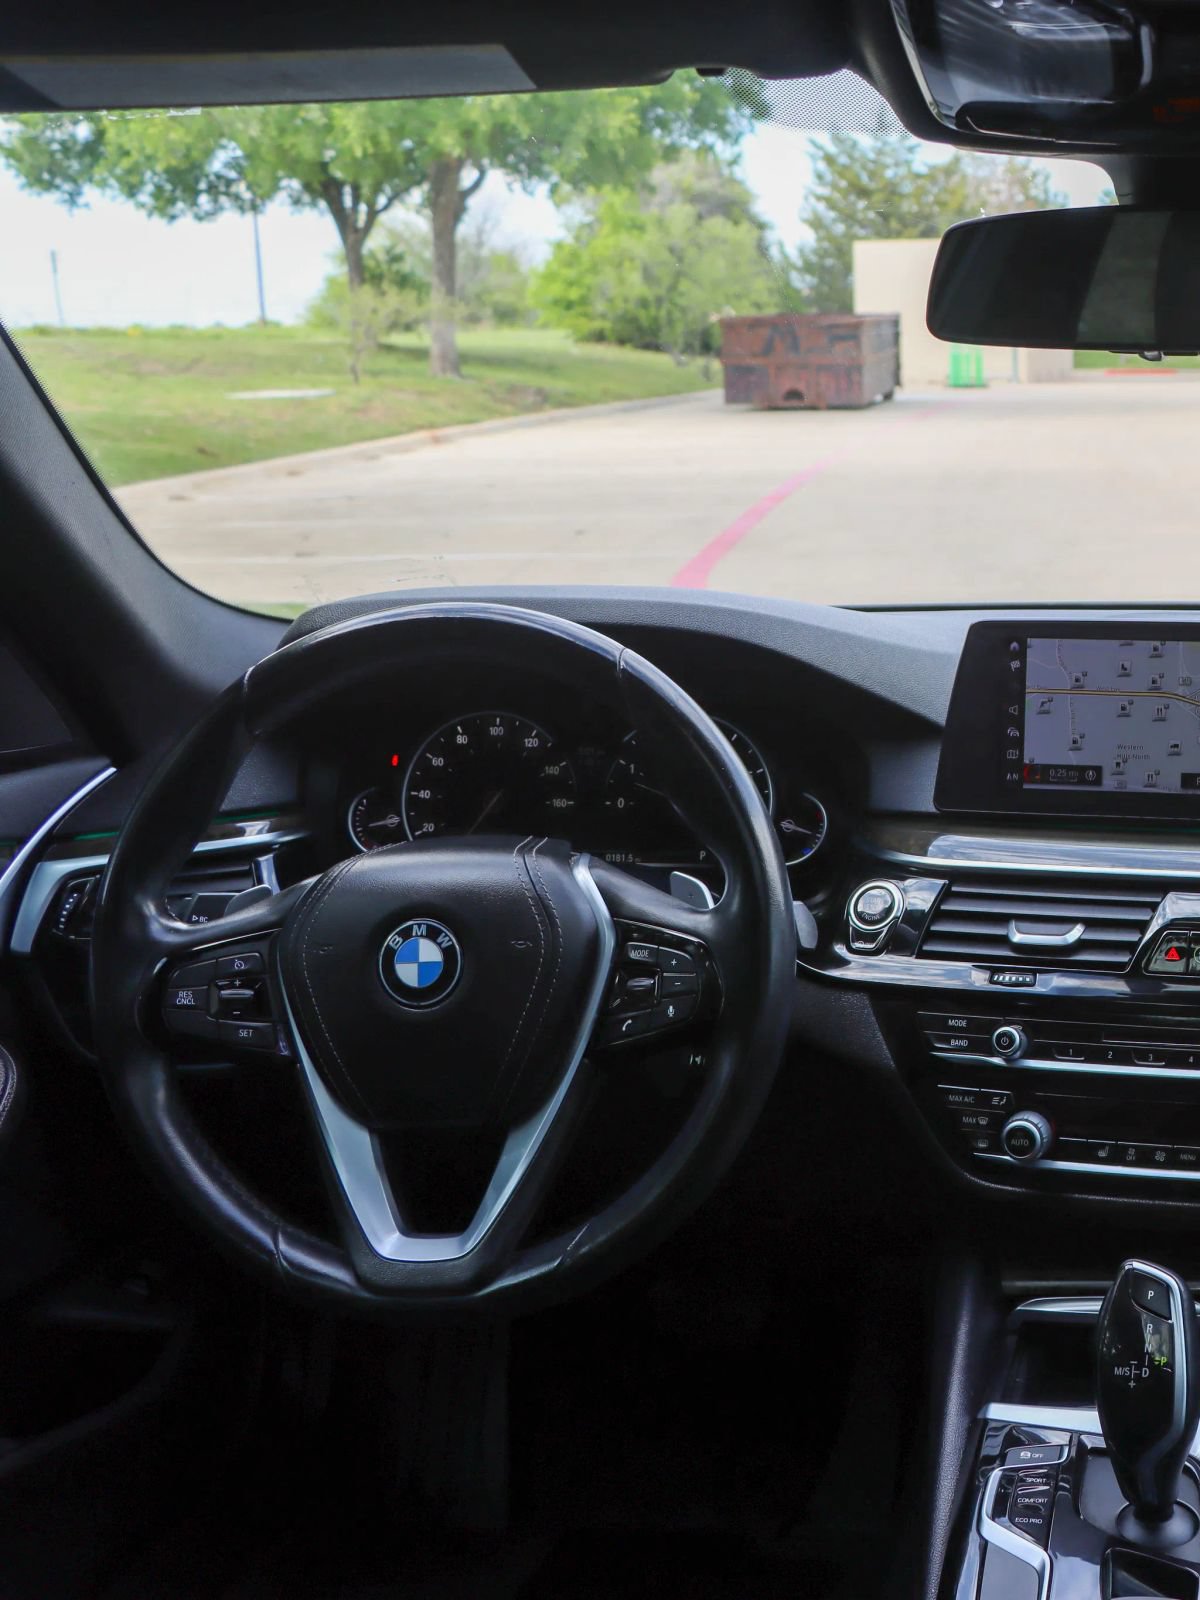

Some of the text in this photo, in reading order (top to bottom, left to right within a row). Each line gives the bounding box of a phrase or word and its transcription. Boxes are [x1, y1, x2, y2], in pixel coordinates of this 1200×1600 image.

[489, 726, 504, 737] 100
[456, 734, 468, 745] 80
[524, 738, 539, 748] 120
[432, 756, 444, 767] 60
[544, 765, 560, 776] 140
[1049, 768, 1067, 777] 0.25
[419, 789, 431, 799] 40
[553, 798, 567, 808] 160
[617, 797, 625, 808] 0
[423, 823, 435, 833] 20
[699, 850, 706, 861] P
[388, 924, 453, 950] BMW
[630, 949, 649, 958] MODE
[178, 990, 193, 999] RES
[176, 998, 196, 1006] CNCL
[948, 1019, 967, 1028] MODE
[238, 1029, 253, 1038] SET
[950, 1038, 969, 1047] BAND
[962, 1116, 976, 1125] MAX
[1010, 1138, 1029, 1147] AUTO
[1180, 1153, 1197, 1161] MENU
[1147, 1290, 1155, 1300] P
[1146, 1323, 1153, 1334] R
[1144, 1343, 1152, 1353] N
[1160, 1356, 1167, 1366] P
[1114, 1366, 1149, 1378] M/S D
